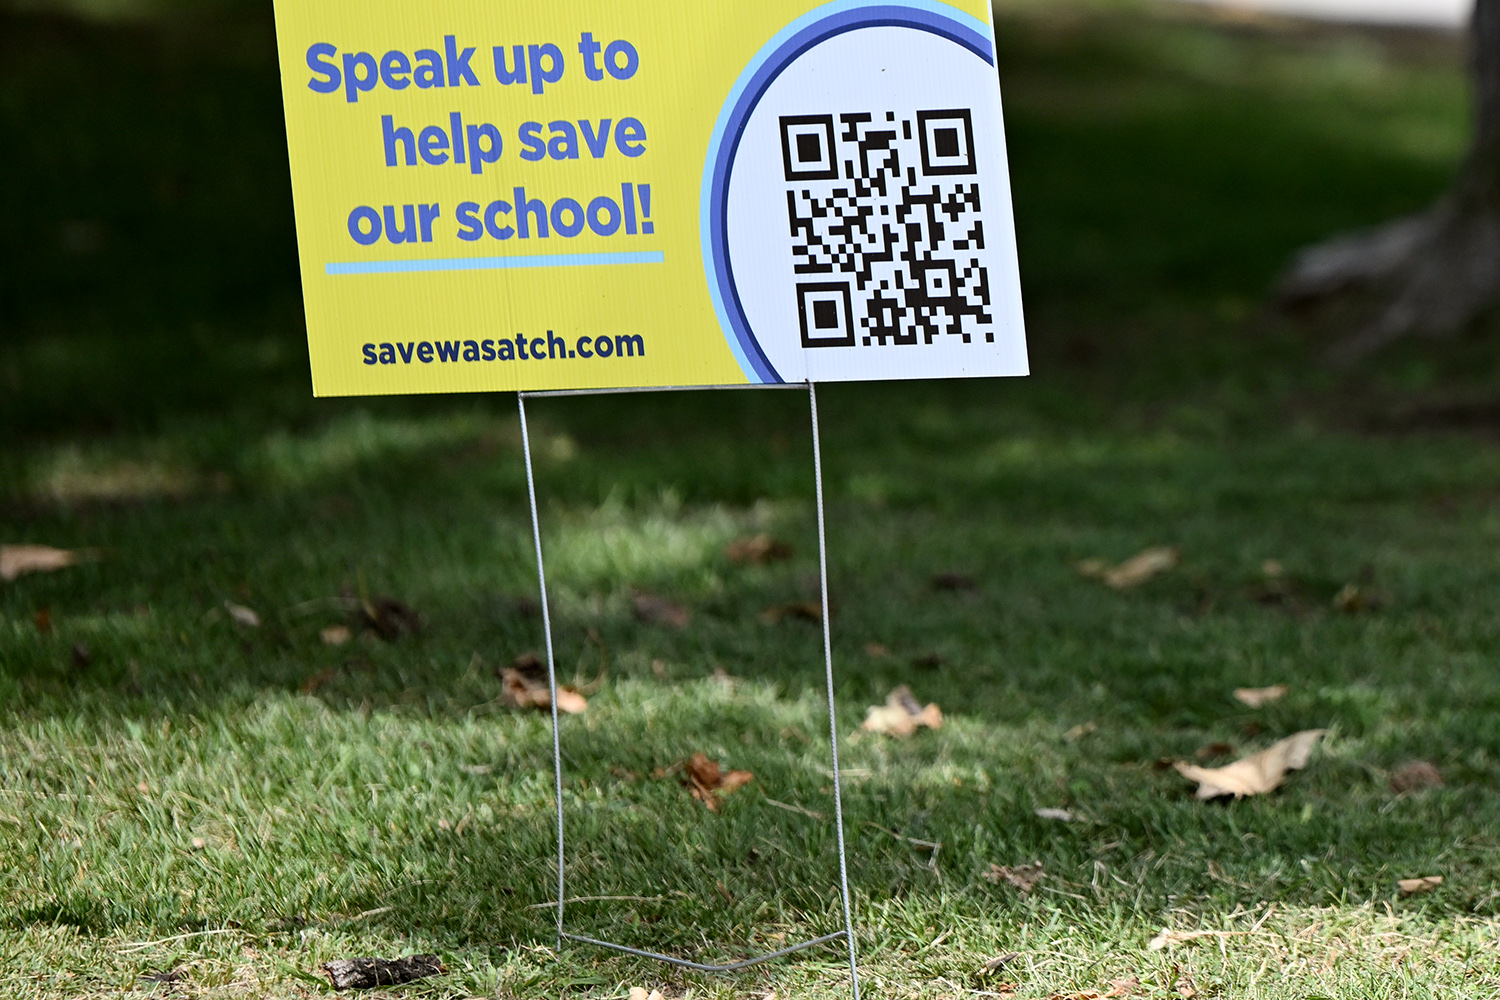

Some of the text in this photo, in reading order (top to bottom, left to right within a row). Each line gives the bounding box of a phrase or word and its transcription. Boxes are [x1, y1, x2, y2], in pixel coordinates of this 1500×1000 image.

[306, 33, 638, 102] Speak up to
[381, 112, 646, 174] help save
[348, 183, 654, 245] our school!
[362, 330, 644, 365] savewasatch.com
